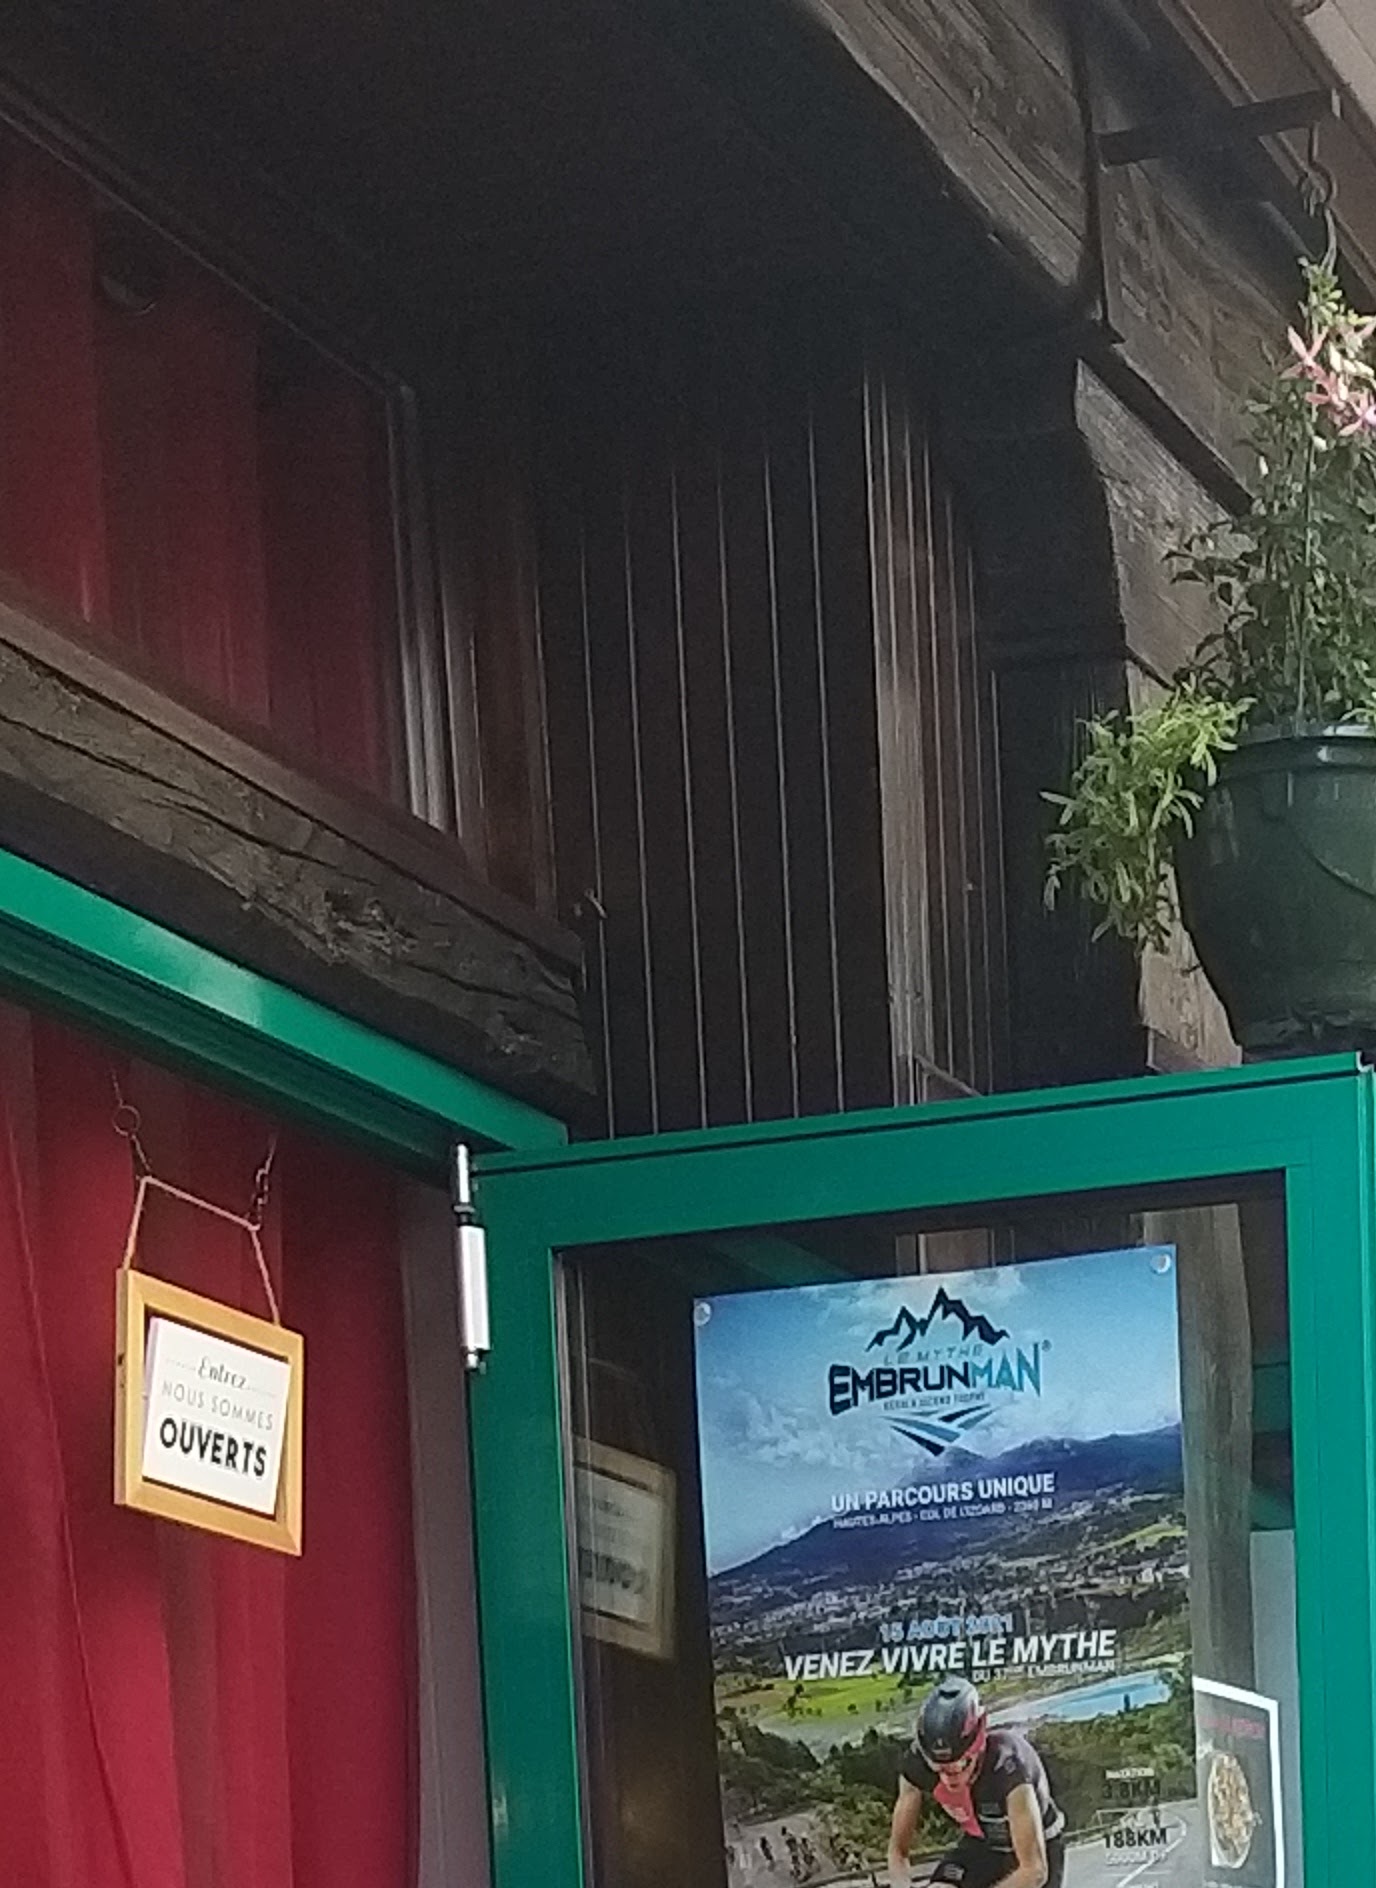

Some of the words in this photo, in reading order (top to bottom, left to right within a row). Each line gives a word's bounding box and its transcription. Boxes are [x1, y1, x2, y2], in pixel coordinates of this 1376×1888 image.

[197, 1356, 247, 1389] Entrez
[161, 1380, 204, 1409] NOUS
[211, 1395, 273, 1431] SOMMES
[159, 1417, 267, 1477] OUVERTS
[831, 1494, 860, 1512] UN
[864, 1481, 974, 1509] PARCOURS
[978, 1473, 1055, 1498] UNIQUE
[784, 1649, 874, 1681] VENEZ
[881, 1641, 965, 1675] VIVRE
[972, 1638, 1006, 1668] LE
[1012, 1629, 1117, 1664] MYTHE
[1103, 1828, 1167, 1849] 188KM
